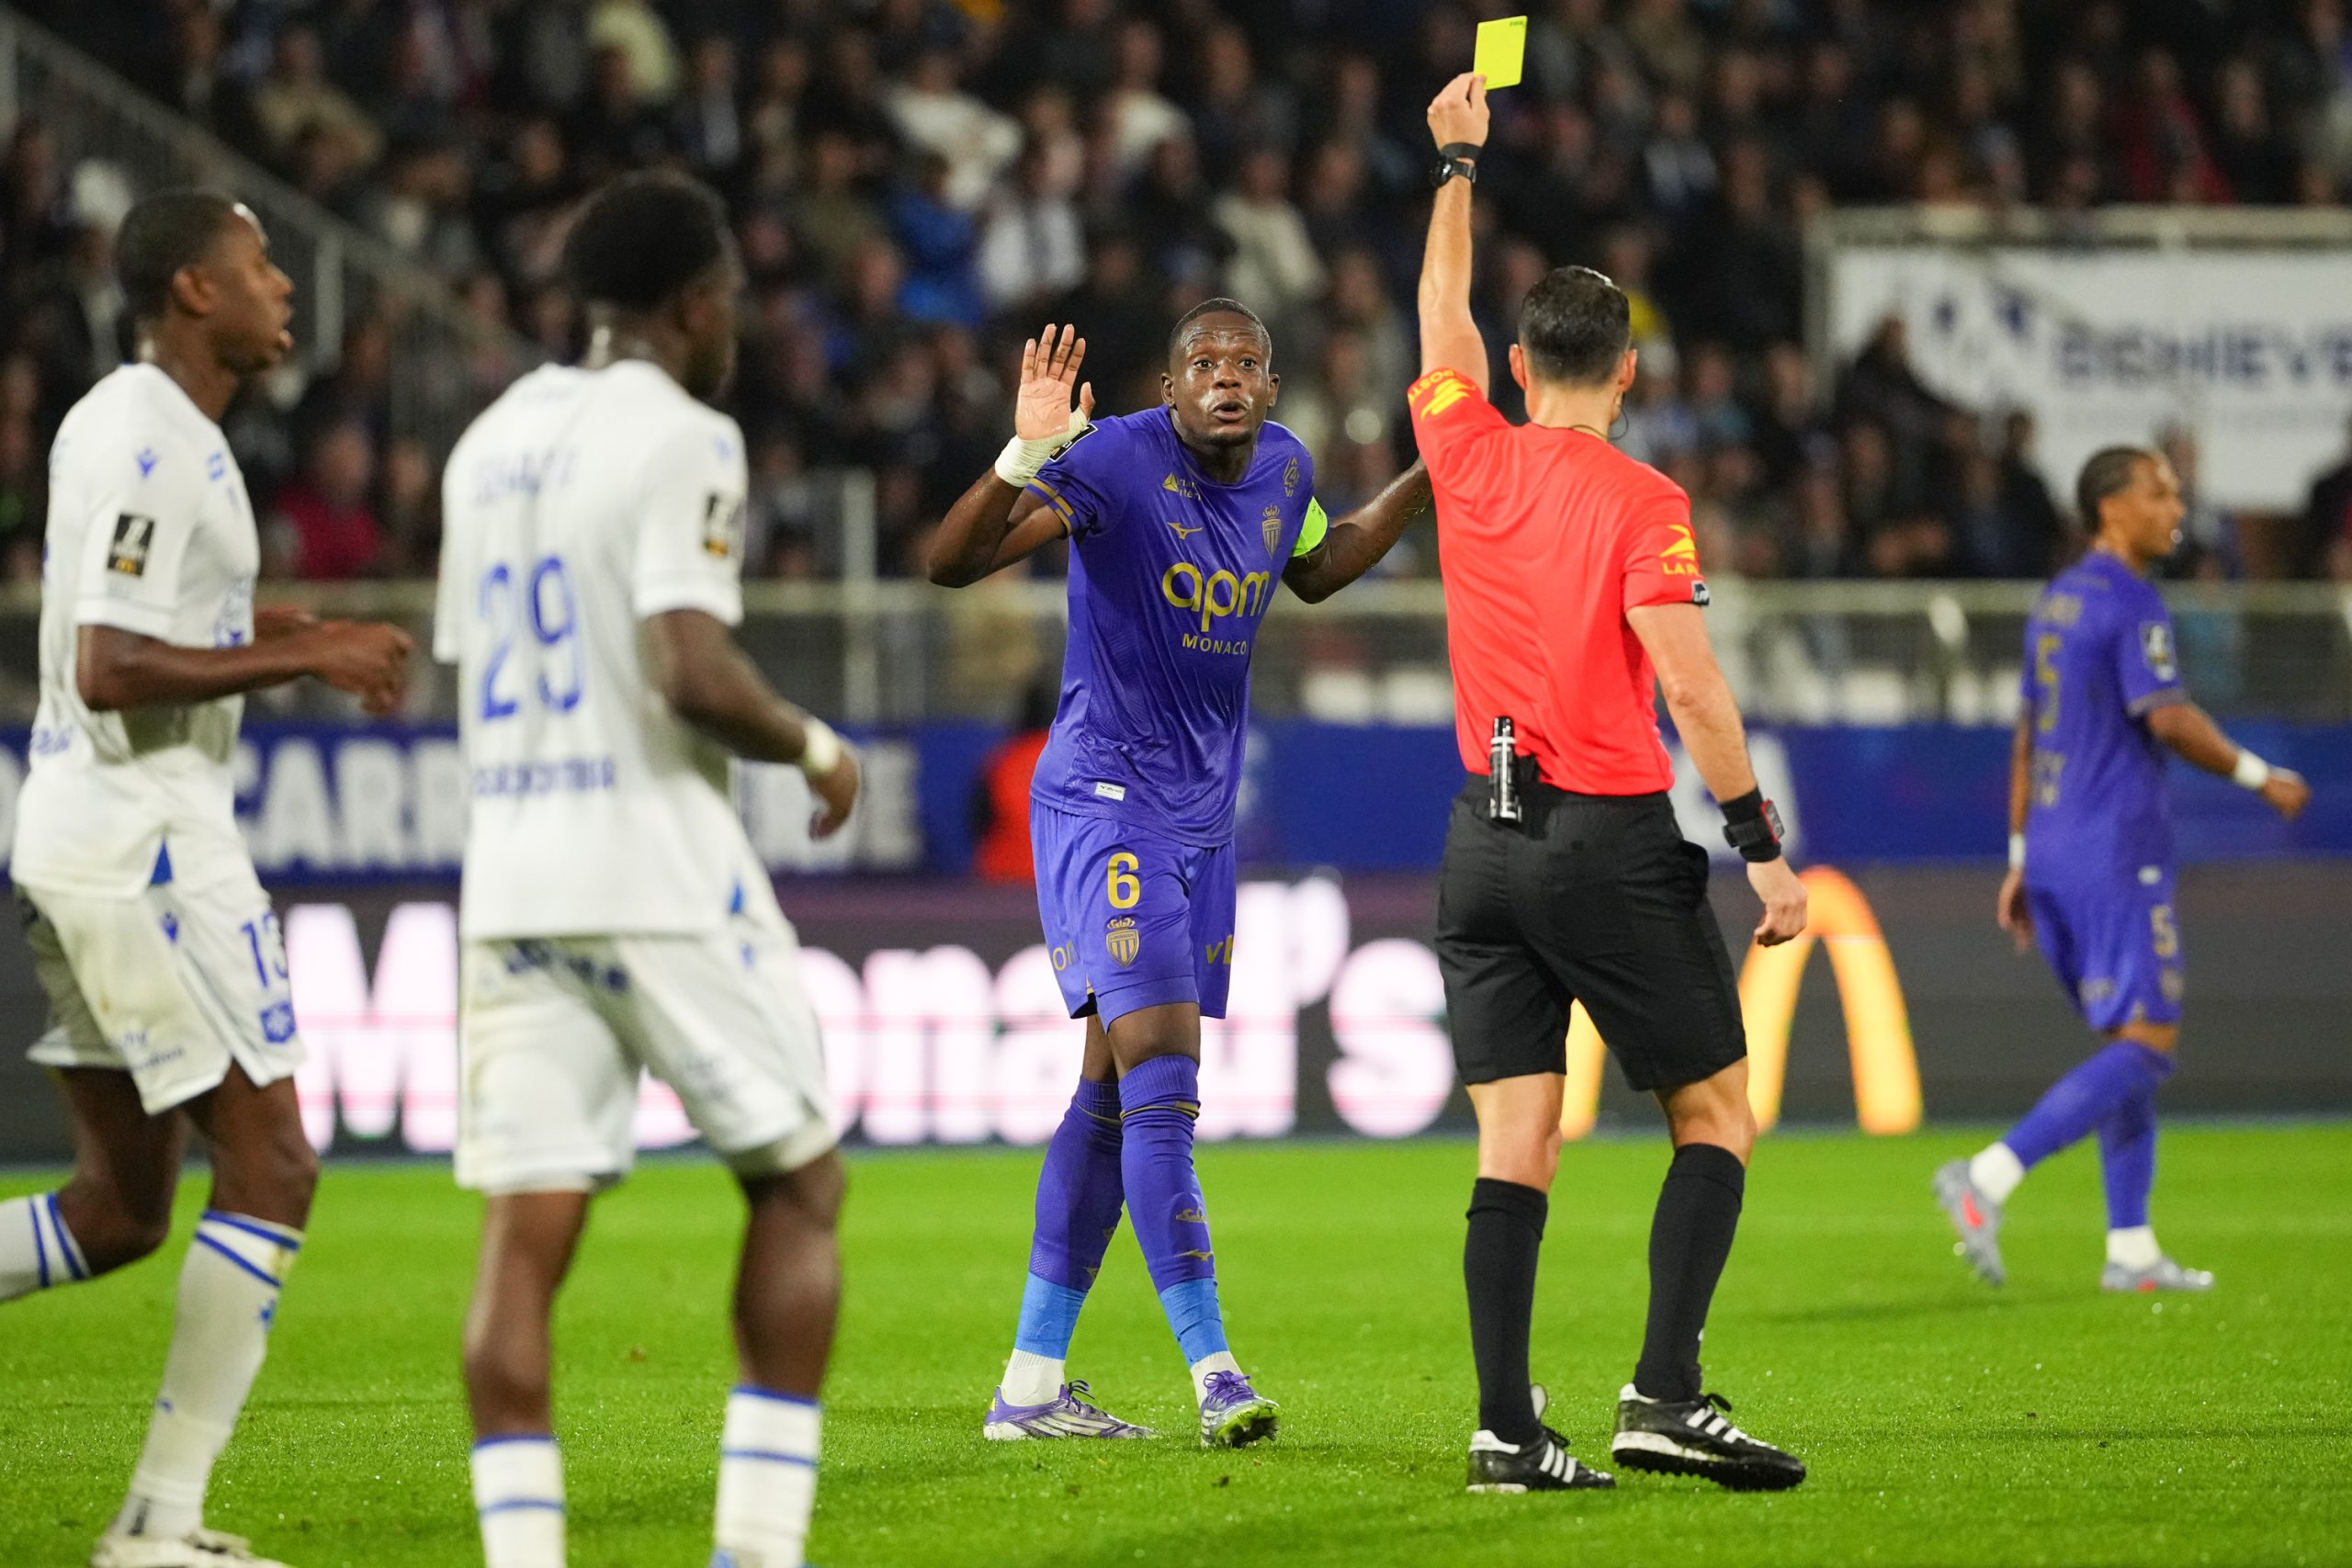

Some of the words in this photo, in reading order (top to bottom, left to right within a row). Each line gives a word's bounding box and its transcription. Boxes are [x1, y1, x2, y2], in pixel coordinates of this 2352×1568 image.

[1162, 561, 1270, 632] apm
[477, 555, 586, 722] 29
[1182, 633, 1247, 655] MONACO
[1107, 852, 1140, 909] 6
[2150, 903, 2178, 958] 5
